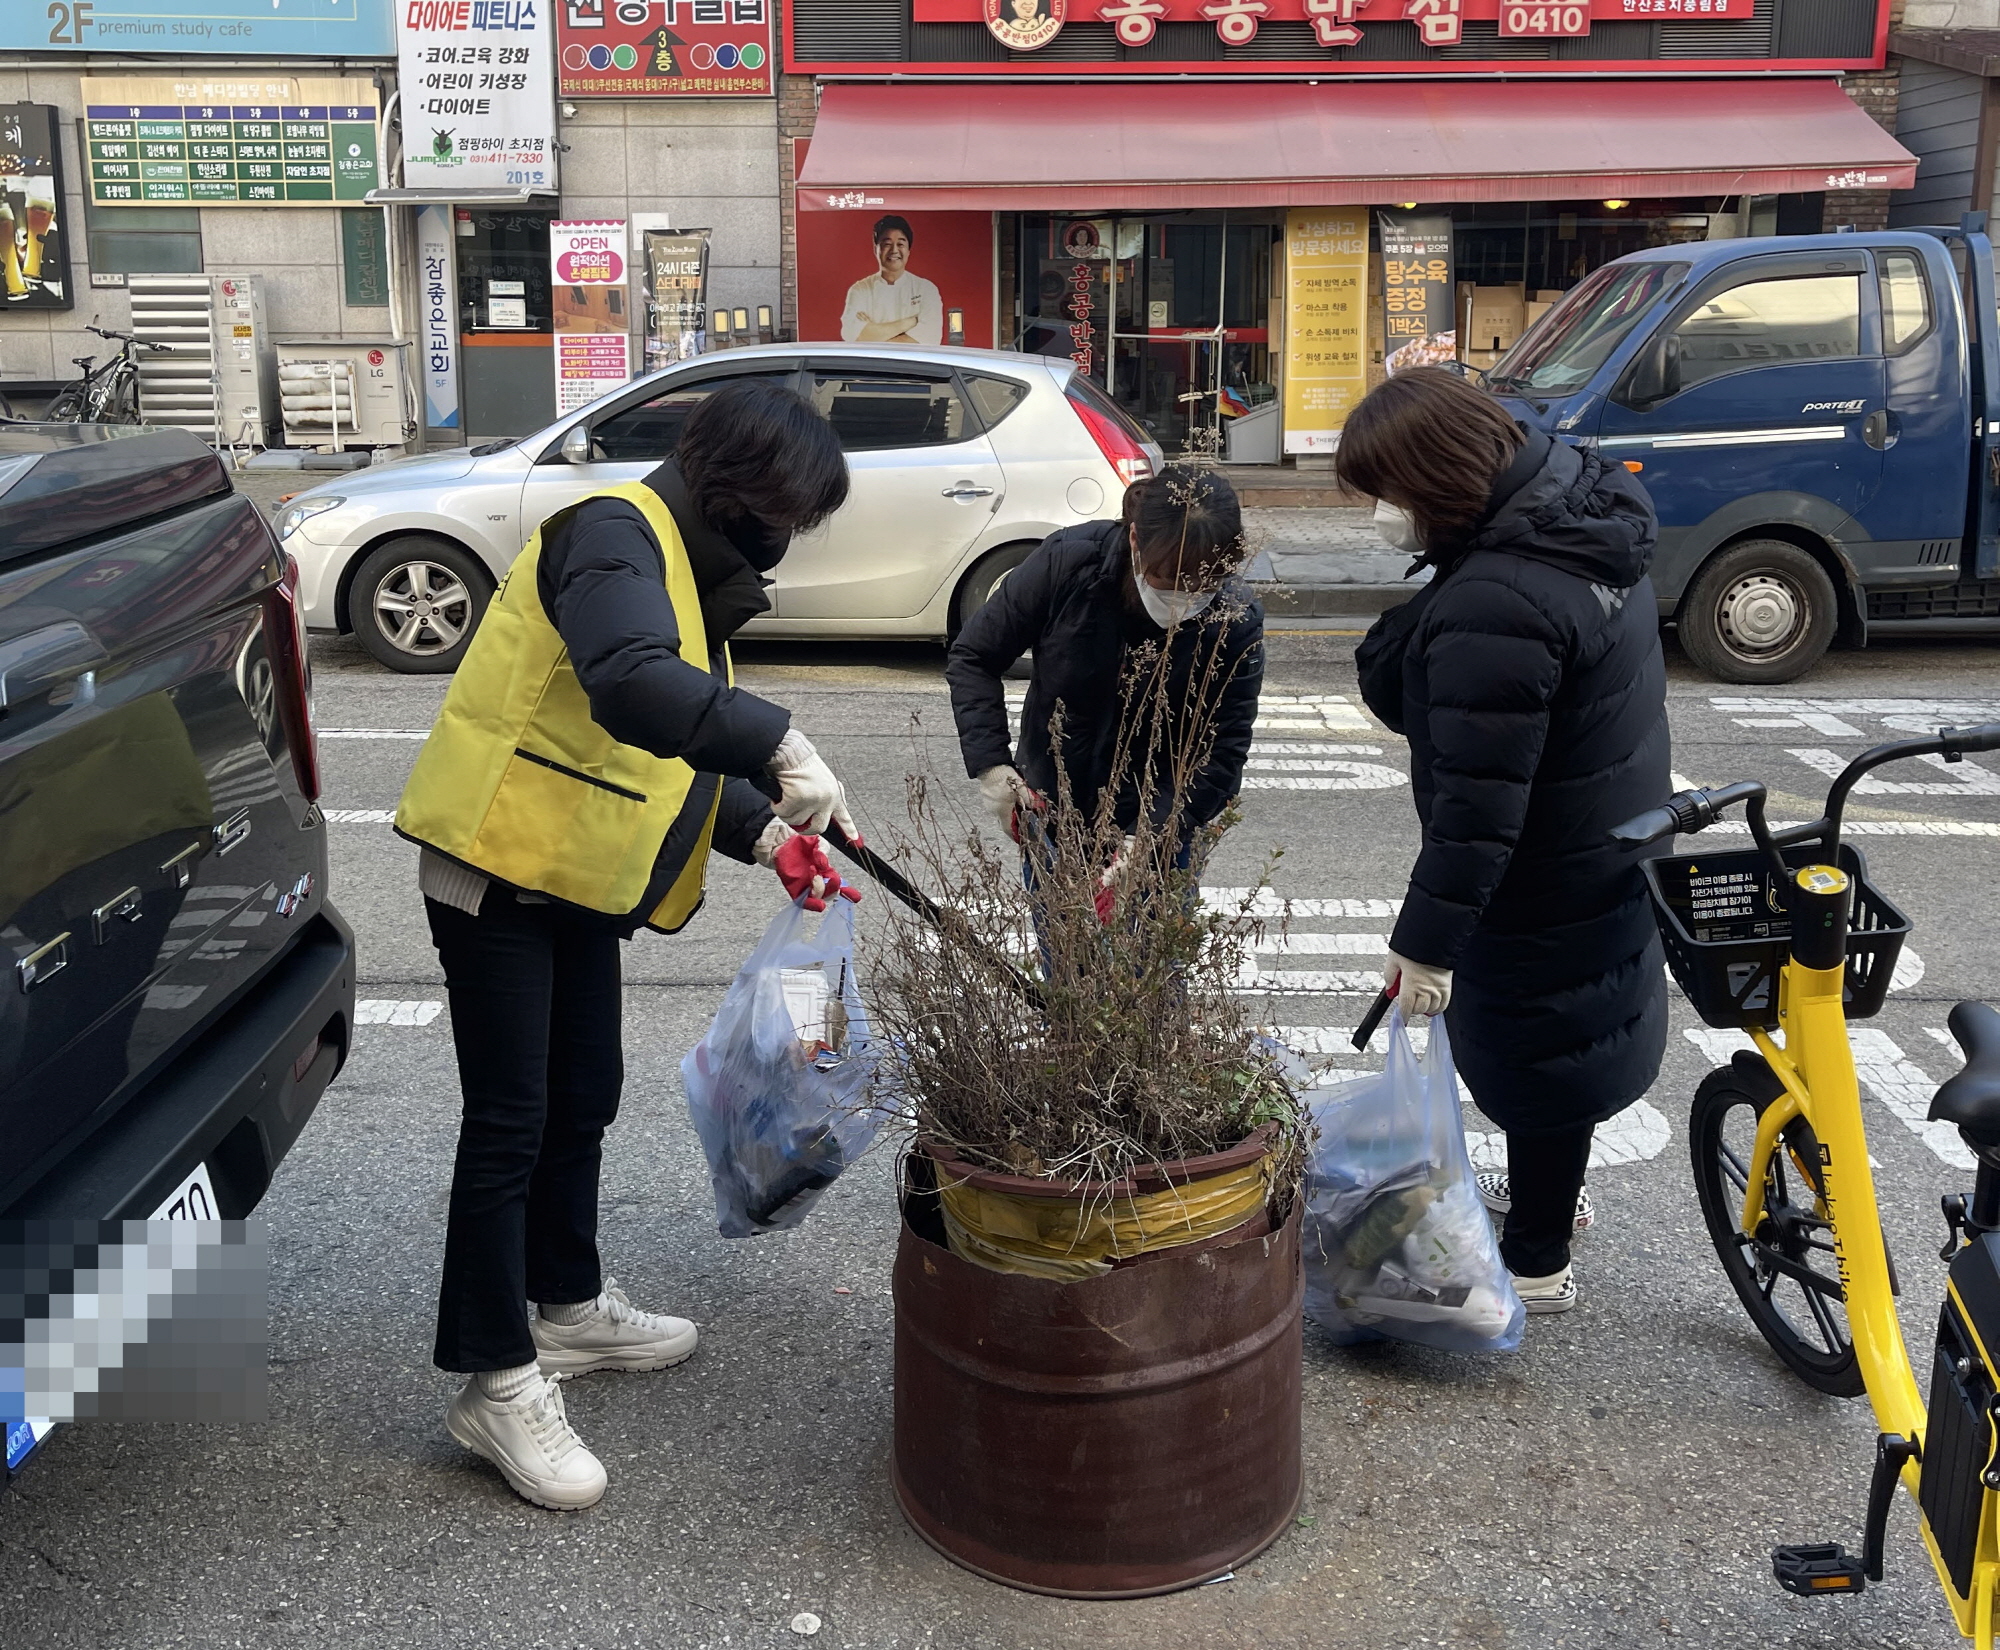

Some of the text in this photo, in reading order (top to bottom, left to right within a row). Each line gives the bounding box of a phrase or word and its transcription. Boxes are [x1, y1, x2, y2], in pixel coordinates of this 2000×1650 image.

[48, 2, 253, 43] 2F premium study cafe
[406, 1, 471, 31] 다이어트
[472, 1, 537, 31] 피트니스
[1507, 7, 1584, 33] 0410
[498, 47, 530, 64] 강화
[426, 73, 527, 90] 어린이 키성장
[265, 83, 289, 98] 안내
[129, 107, 359, 118] 1층 2층 3층 4층 5층
[427, 98, 491, 115] 다이어트
[210, 145, 229, 157] 스터디
[457, 138, 545, 151] 점핑하이 초지점
[506, 171, 545, 185] 201호
[570, 237, 608, 249] OPEN
[1291, 239, 1365, 256] 방문하세요
[1427, 244, 1449, 253] 모으면
[570, 255, 610, 267] 원적외선
[657, 261, 701, 275] 24시 더존
[1385, 259, 1448, 285] 탕수육
[224, 299, 238, 308] LG
[1386, 287, 1427, 312] 증정
[425, 255, 449, 373] 참좋은교회
[1306, 303, 1347, 312] 마스크 착용
[1068, 264, 1096, 377] 홍콩반점
[1389, 318, 1425, 335] 1박스
[1342, 328, 1358, 336] 비치
[1306, 353, 1321, 361] 위생
[1323, 353, 1340, 361] 교육
[370, 369, 384, 378] LG
[435, 379, 447, 388] 5F
[1802, 401, 1852, 413] PORTER
[1689, 876, 1712, 887] 바이크
[1712, 875, 1727, 885] 이용
[1744, 872, 1753, 882] 시
[1691, 887, 1714, 898] 자전거
[1744, 884, 1759, 893] 있는
[1693, 910, 1715, 920] 이용이
[1822, 1173, 1838, 1235] kakao
[1834, 1238, 1844, 1252] T
